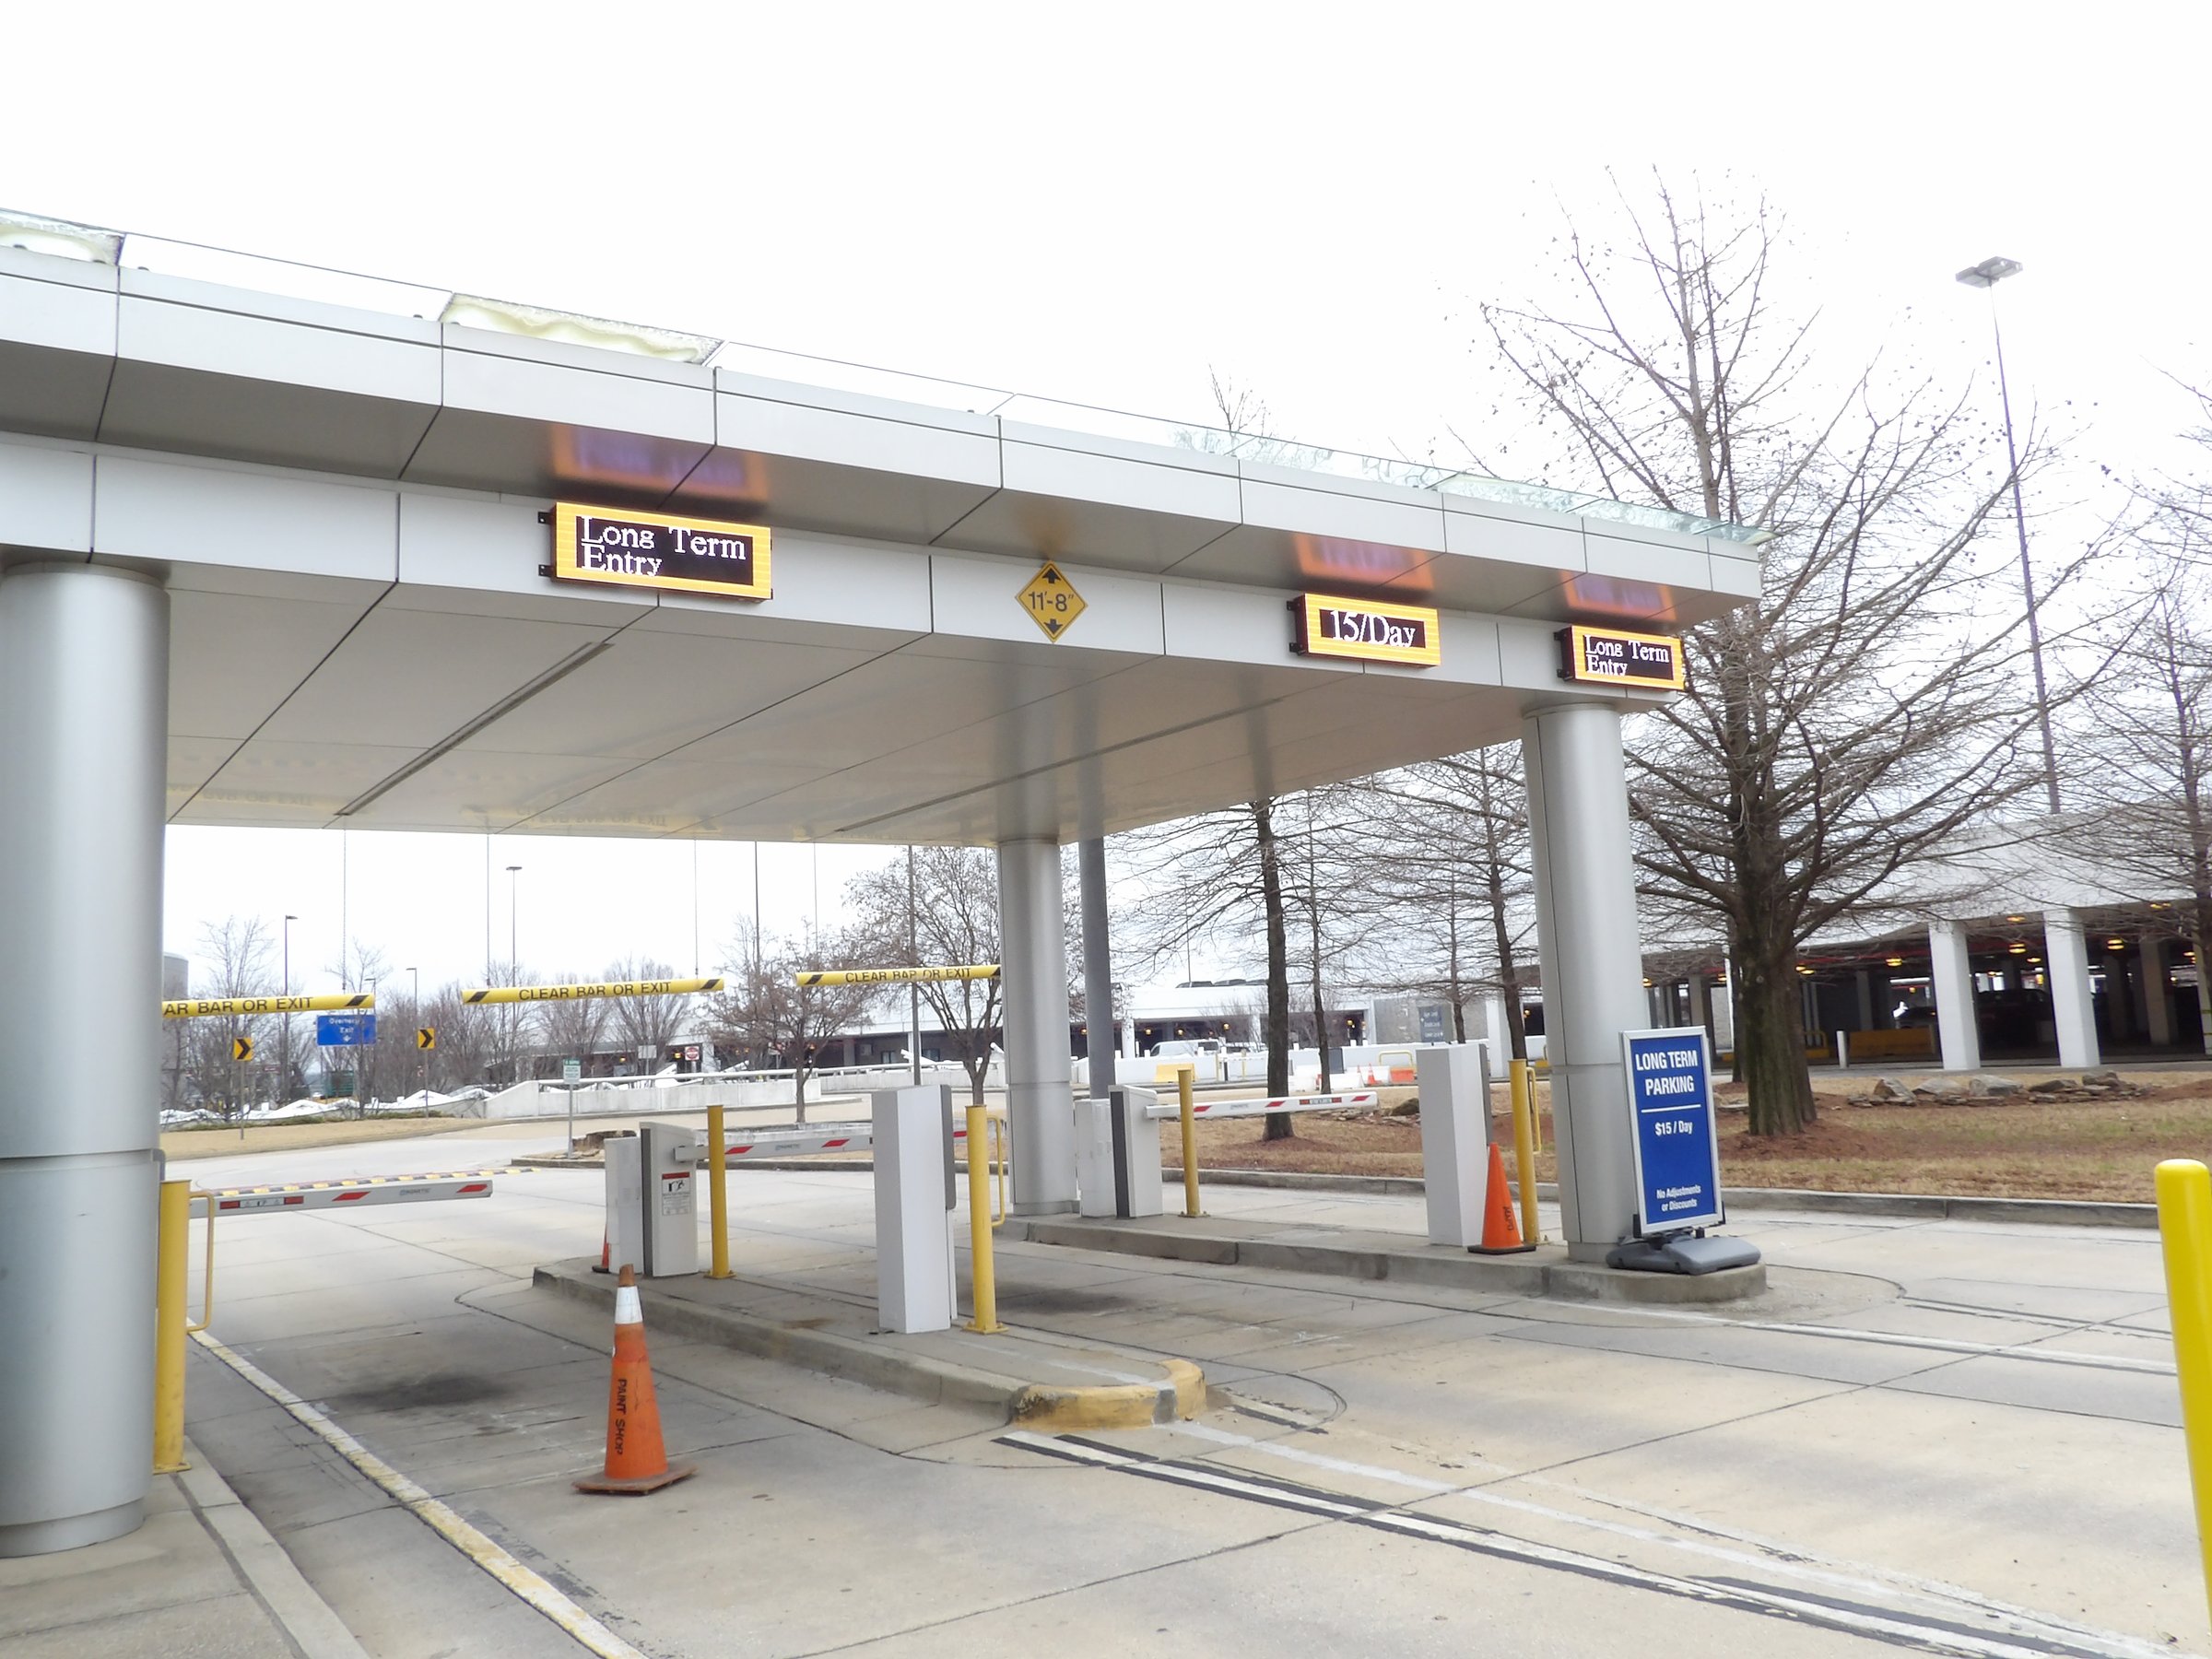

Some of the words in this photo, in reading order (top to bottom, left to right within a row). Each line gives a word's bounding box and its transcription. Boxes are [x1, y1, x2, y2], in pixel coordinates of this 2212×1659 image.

[581, 514, 655, 550] Long
[668, 525, 747, 560] Term
[581, 542, 663, 577] Entry
[1330, 609, 1417, 649] 15/Day
[1584, 634, 1624, 658] Long
[1628, 640, 1670, 664] Term
[1586, 653, 1629, 677] Entry
[845, 971, 888, 983] CLEAR
[923, 969, 941, 980] OR
[946, 968, 971, 978] EXIT
[518, 987, 570, 1001] CLEAR
[576, 985, 606, 997] BAR
[613, 983, 634, 995] OR
[641, 982, 672, 994] EXIT
[197, 1001, 234, 1014] BAR
[242, 998, 267, 1012] OR
[276, 996, 314, 1010] EXIT
[1635, 1052, 1668, 1071] LONG
[1667, 1049, 1699, 1068] TERM
[1644, 1075, 1696, 1097] PARKING
[1654, 1121, 1673, 1136] $15
[1673, 1120, 1677, 1135] /
[1677, 1120, 1694, 1135] Day
[1656, 1188, 1666, 1200] No
[1665, 1183, 1702, 1199] Adjustments
[1661, 1203, 1669, 1212] or
[1668, 1197, 1698, 1211] Discounts
[616, 1379, 628, 1416] PAINT
[615, 1418, 626, 1455] SHOP
